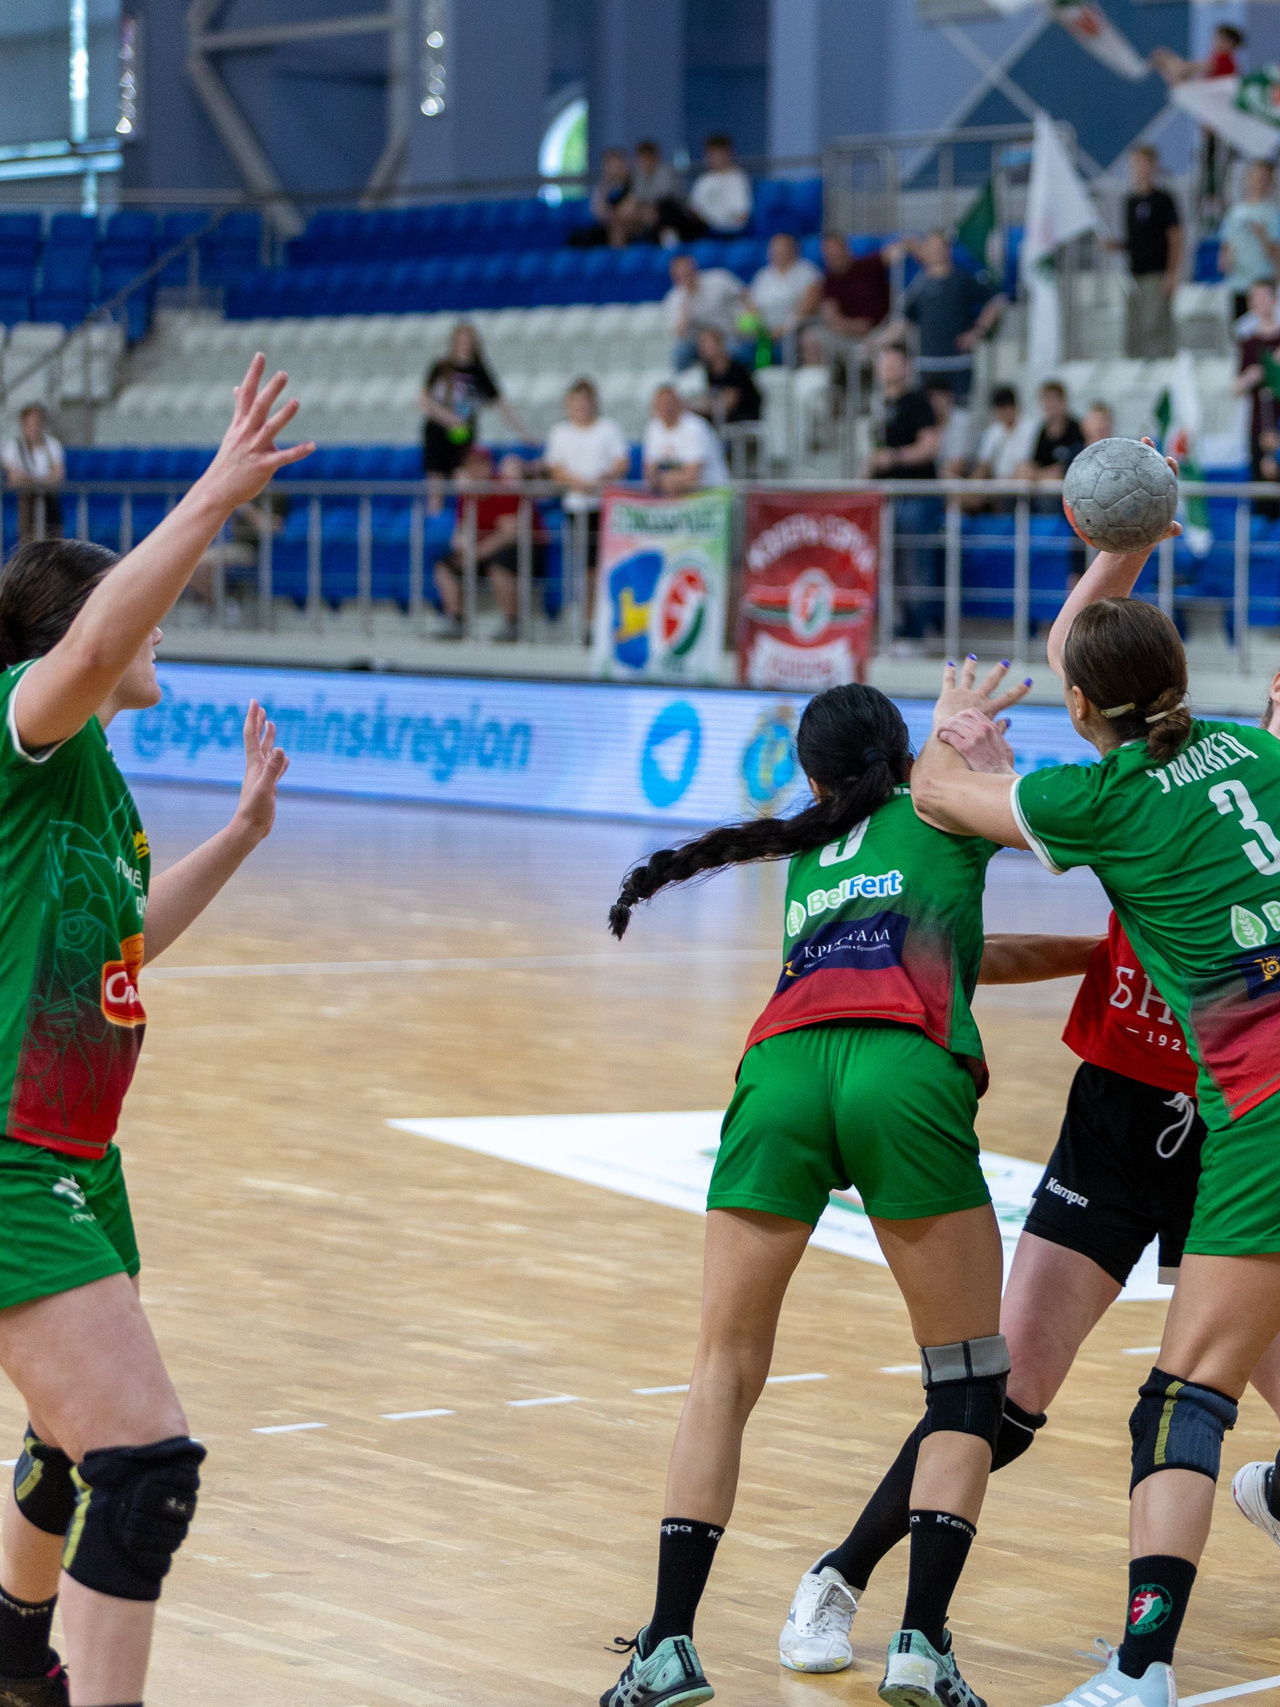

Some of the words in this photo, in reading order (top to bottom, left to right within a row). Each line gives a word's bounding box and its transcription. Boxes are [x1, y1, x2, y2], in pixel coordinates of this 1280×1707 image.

[133, 680, 533, 783] @spotminskregion
[807, 870, 903, 917] BelFert
[1109, 966, 1174, 1026] БН
[1146, 1030, 1191, 1055] 192
[1046, 1177, 1089, 1208] Kempa
[661, 1524, 692, 1535] mpa
